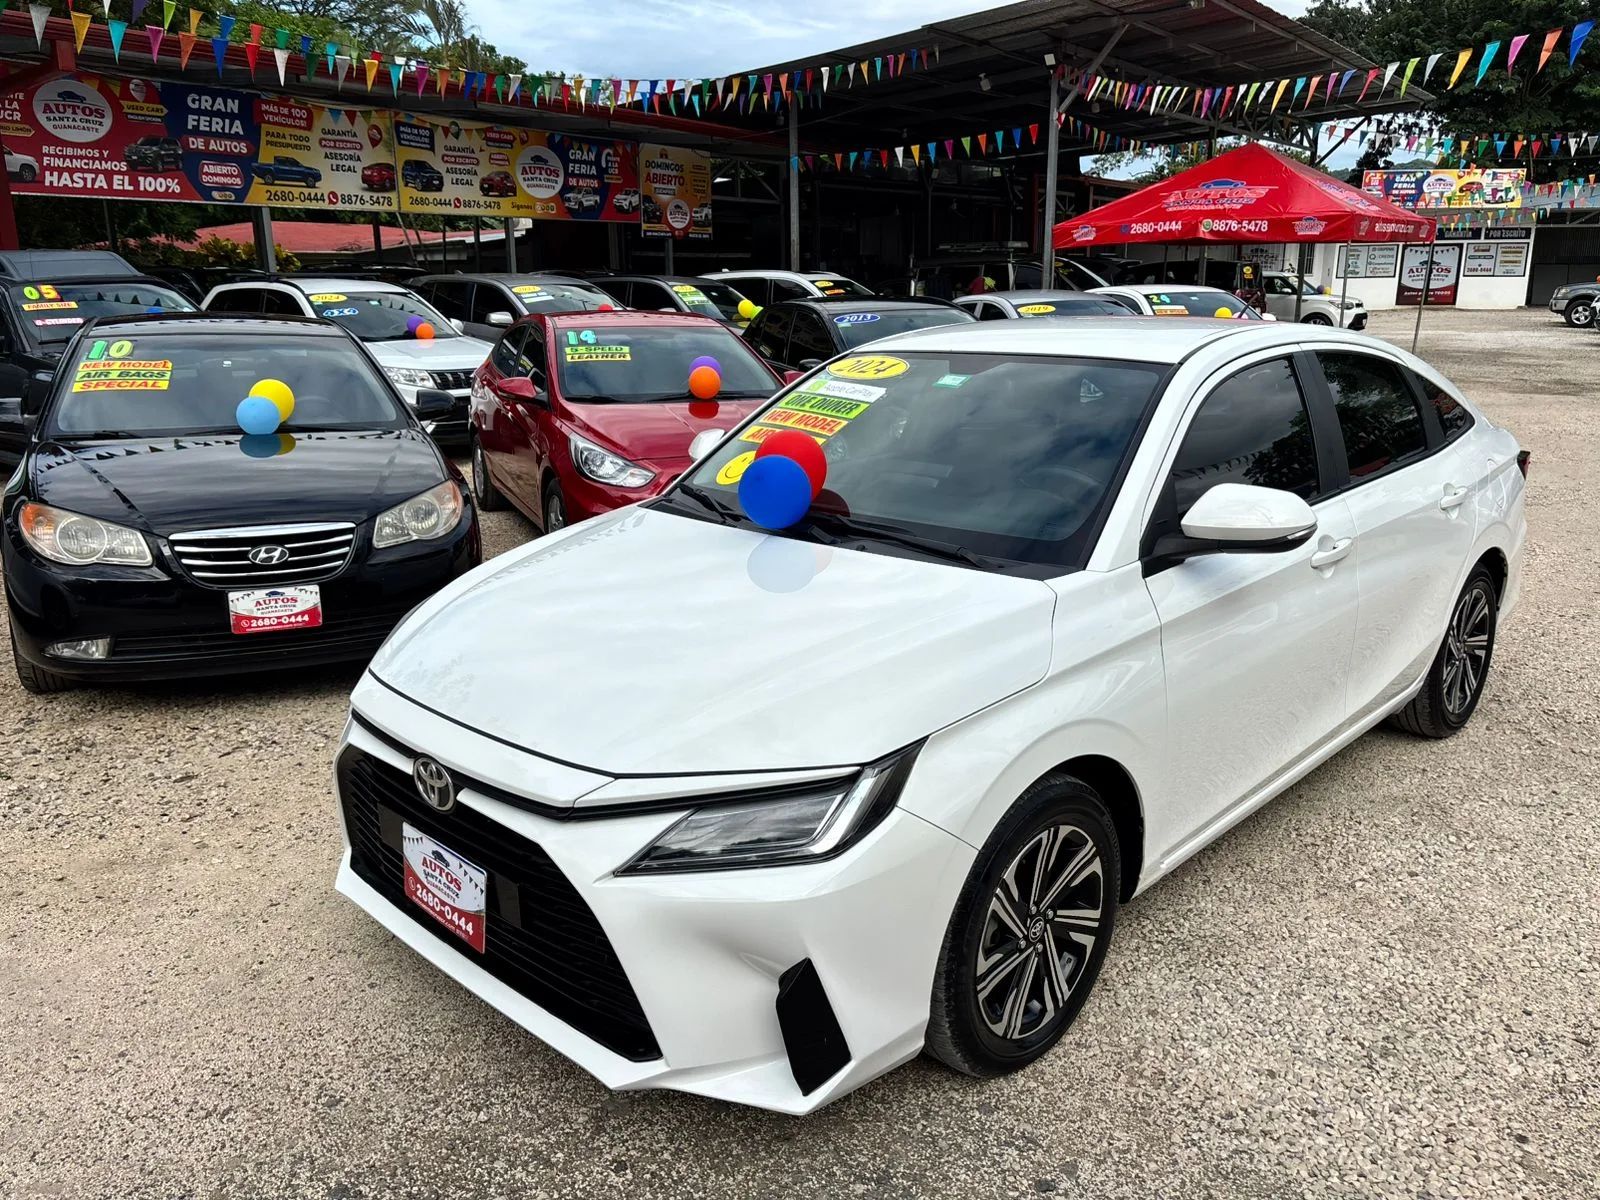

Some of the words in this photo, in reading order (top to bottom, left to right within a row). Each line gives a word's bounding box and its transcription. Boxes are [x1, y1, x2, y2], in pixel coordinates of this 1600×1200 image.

[187, 93, 239, 114] GRAN
[43, 103, 106, 119] AUTOS
[280, 106, 289, 115] DE
[291, 107, 308, 119] 100
[53, 124, 100, 133] GUANACASTE
[79, 118, 104, 127] CRUZ
[187, 114, 244, 136] FERIA
[265, 131, 287, 141] PARA
[289, 133, 311, 143] TODO
[42, 146, 99, 158] RECIBIMOS
[101, 150, 109, 158] Y
[189, 137, 205, 150] DE
[208, 139, 248, 154] AUTOS
[265, 141, 312, 152] PRESUPUESTO
[335, 141, 361, 150] ESCRITO
[324, 152, 362, 162] ASESORÍA
[568, 150, 596, 162] GRAN
[43, 157, 127, 171] FINANCIAMOS
[202, 164, 239, 176] ABIERTO
[331, 164, 357, 173] LEGAL
[568, 163, 597, 176] FERIA
[645, 160, 684, 173] DOMINGOS
[521, 166, 560, 178] AUTOS
[45, 171, 108, 190] HASTA
[113, 174, 134, 191] EL
[138, 176, 181, 194] 100%
[202, 173, 241, 185] DOMINGOS
[451, 178, 474, 186] LEGAL
[568, 177, 577, 186] DE
[578, 179, 599, 188] AUTOS
[645, 172, 685, 186] ABIERTO
[265, 190, 326, 204] 2680-0444
[340, 194, 393, 207] 8876-5478
[409, 195, 452, 207] 2680-0444
[463, 199, 501, 210] 8876-5478
[1131, 221, 1182, 234] 2680-0444
[1212, 219, 1269, 231] 8876-5478
[1489, 230, 1501, 238] POR
[23, 284, 62, 300] 05
[843, 313, 871, 323] 2013
[84, 340, 134, 360] 10
[81, 362, 114, 370] NEW
[119, 360, 170, 369] MODEL
[832, 359, 901, 375] 2024
[80, 371, 112, 379] AIR
[116, 370, 168, 378] BAGS
[80, 381, 163, 390] SPECIAL
[784, 393, 812, 409] ONE
[810, 397, 861, 415] OWNER
[765, 408, 792, 421] NEW
[790, 413, 843, 433] MODEL
[254, 597, 298, 608] AUTOS
[250, 614, 310, 627] 2680-0444
[421, 856, 462, 892] AUTOS
[423, 869, 442, 886] SANTA
[416, 883, 474, 936] 2680-0444
